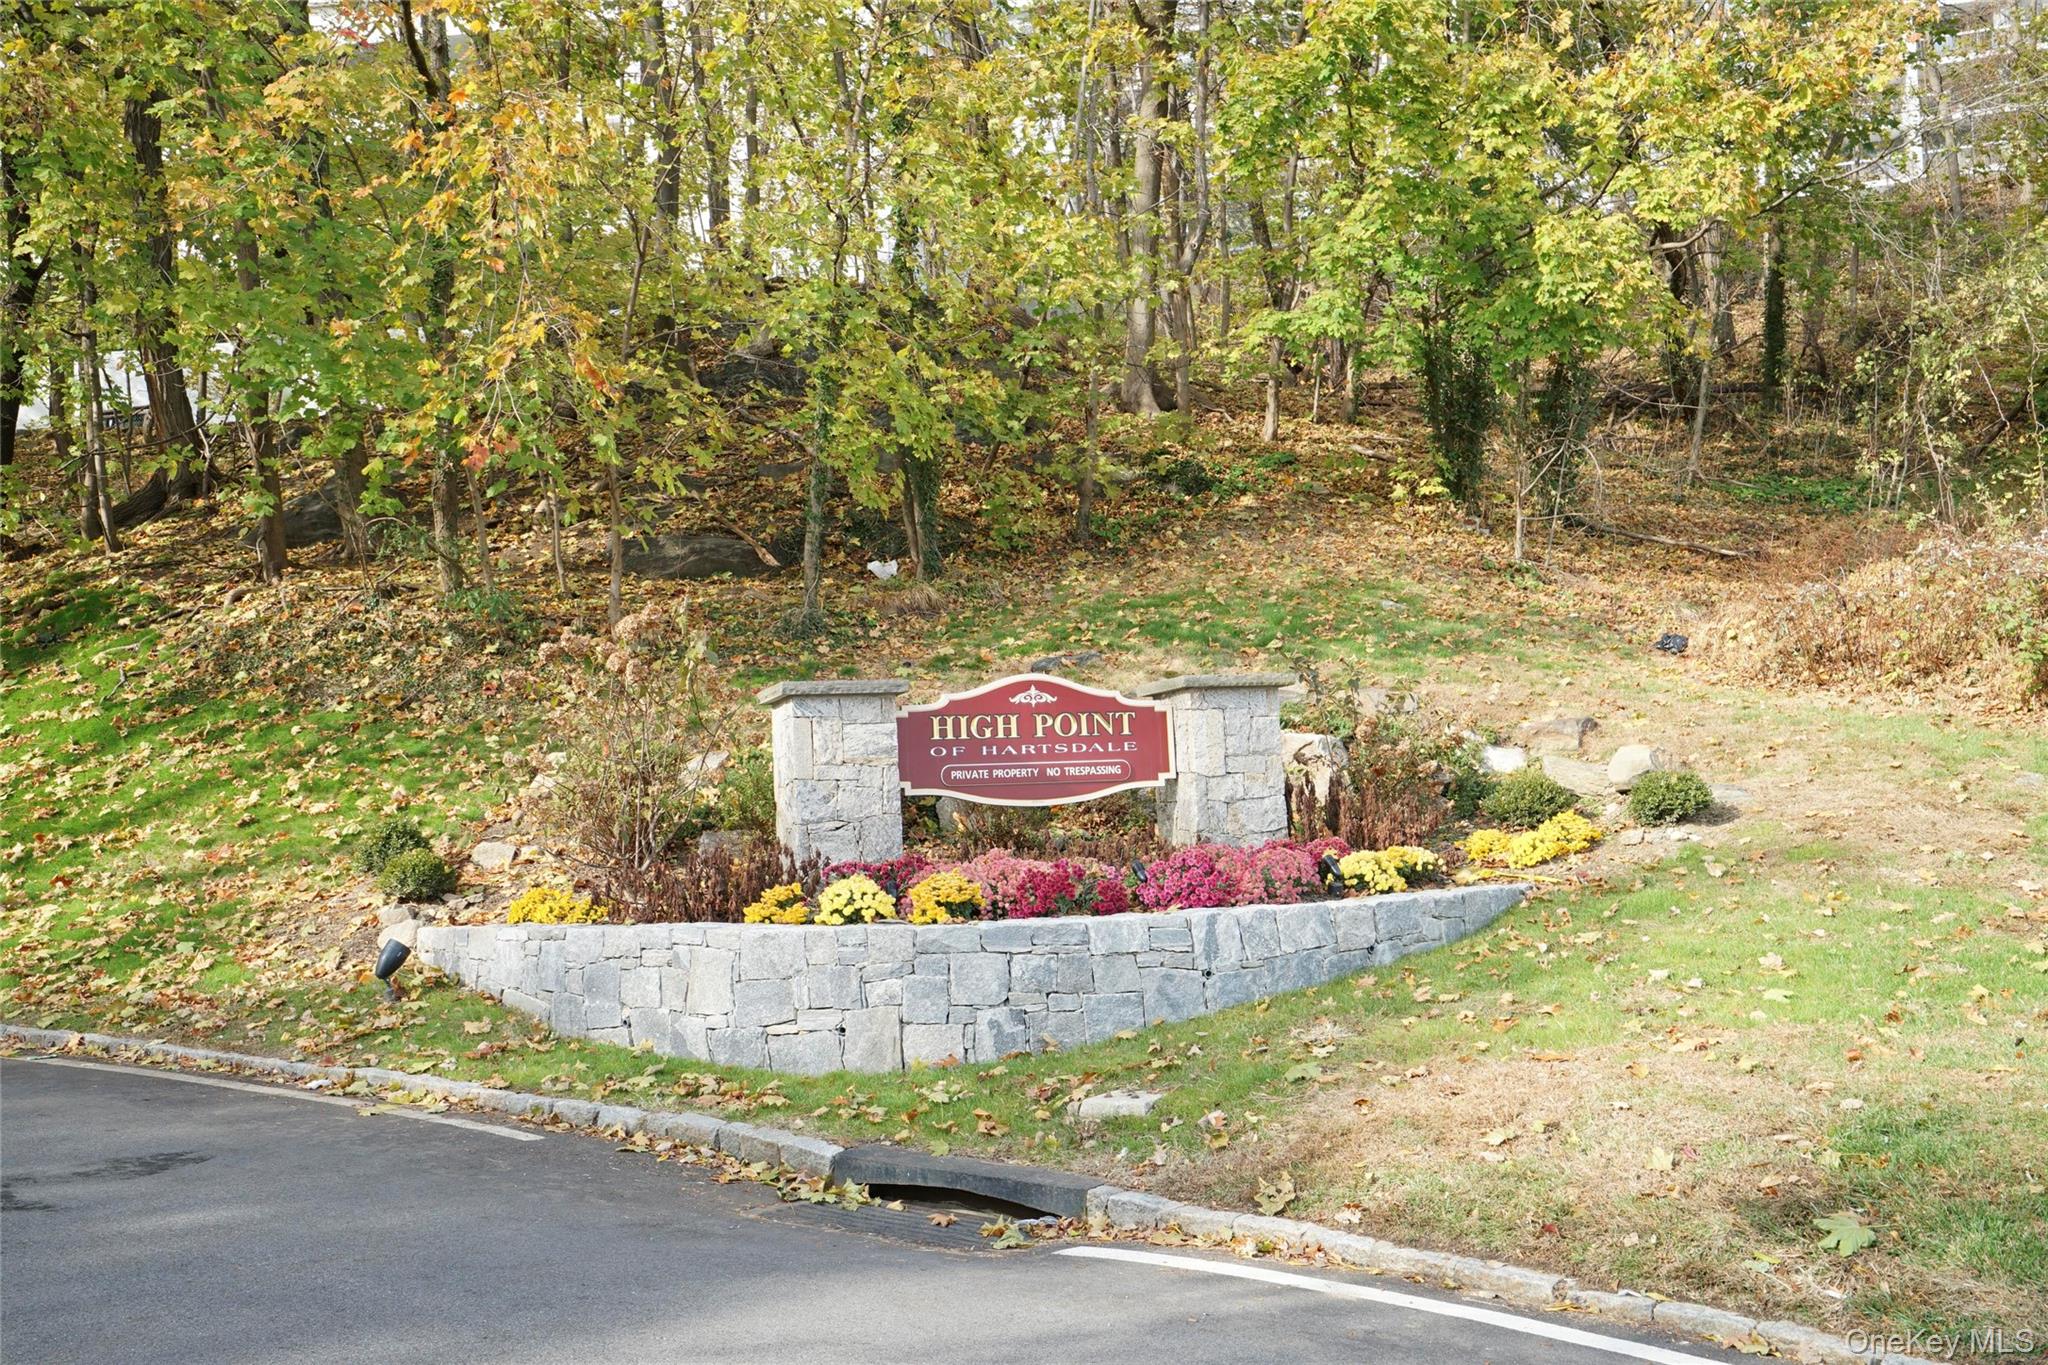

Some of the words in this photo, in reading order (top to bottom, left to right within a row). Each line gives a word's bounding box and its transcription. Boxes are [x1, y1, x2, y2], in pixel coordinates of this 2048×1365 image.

[930, 714, 1020, 740] HIGH
[1032, 712, 1136, 738] POINT
[930, 746, 966, 757] OF
[982, 742, 1138, 756] HARTSDALE
[951, 769, 990, 780] PRIVATE
[992, 767, 1039, 778] PROPERTY
[1046, 767, 1061, 777] NO
[1064, 765, 1122, 776] TRESPASSING
